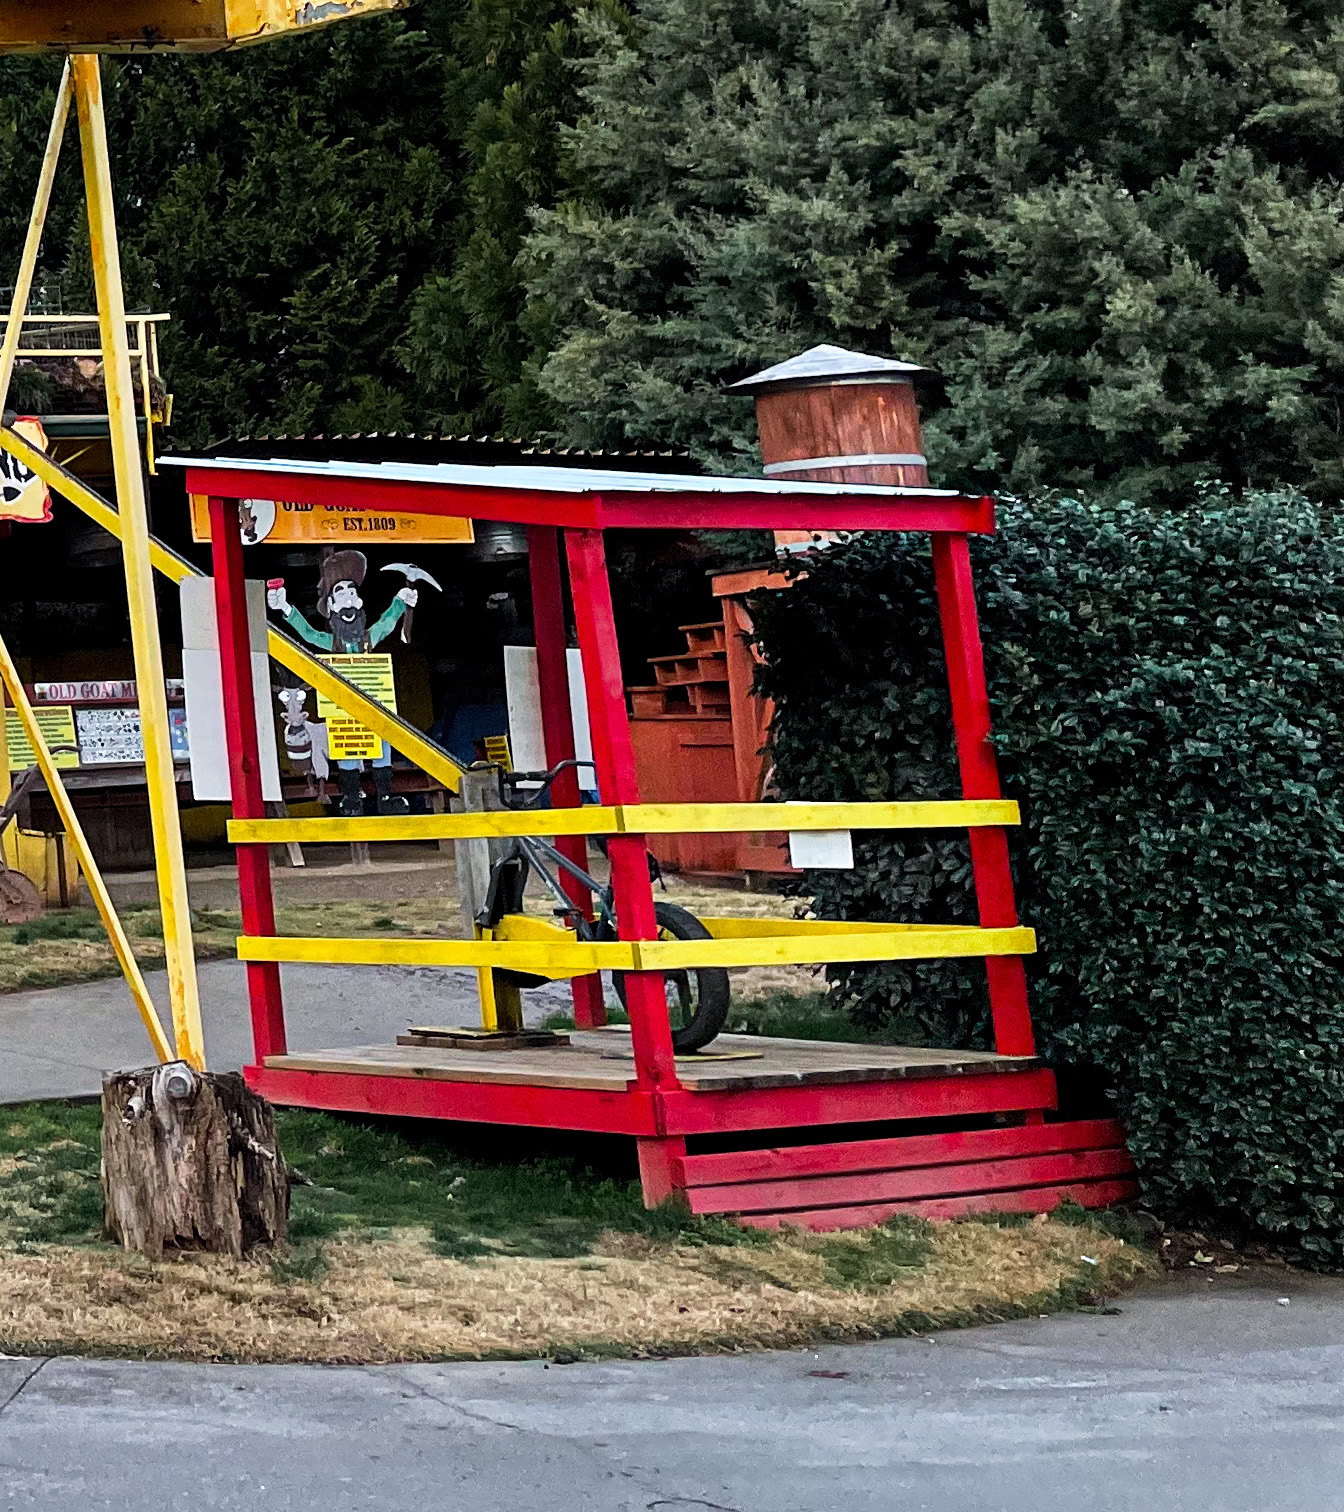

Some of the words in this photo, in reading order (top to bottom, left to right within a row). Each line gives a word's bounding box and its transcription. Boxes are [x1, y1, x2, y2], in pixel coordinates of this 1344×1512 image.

[343, 517, 396, 531] EST.1809
[49, 683, 76, 700] OLD
[80, 681, 118, 699] GOAT
